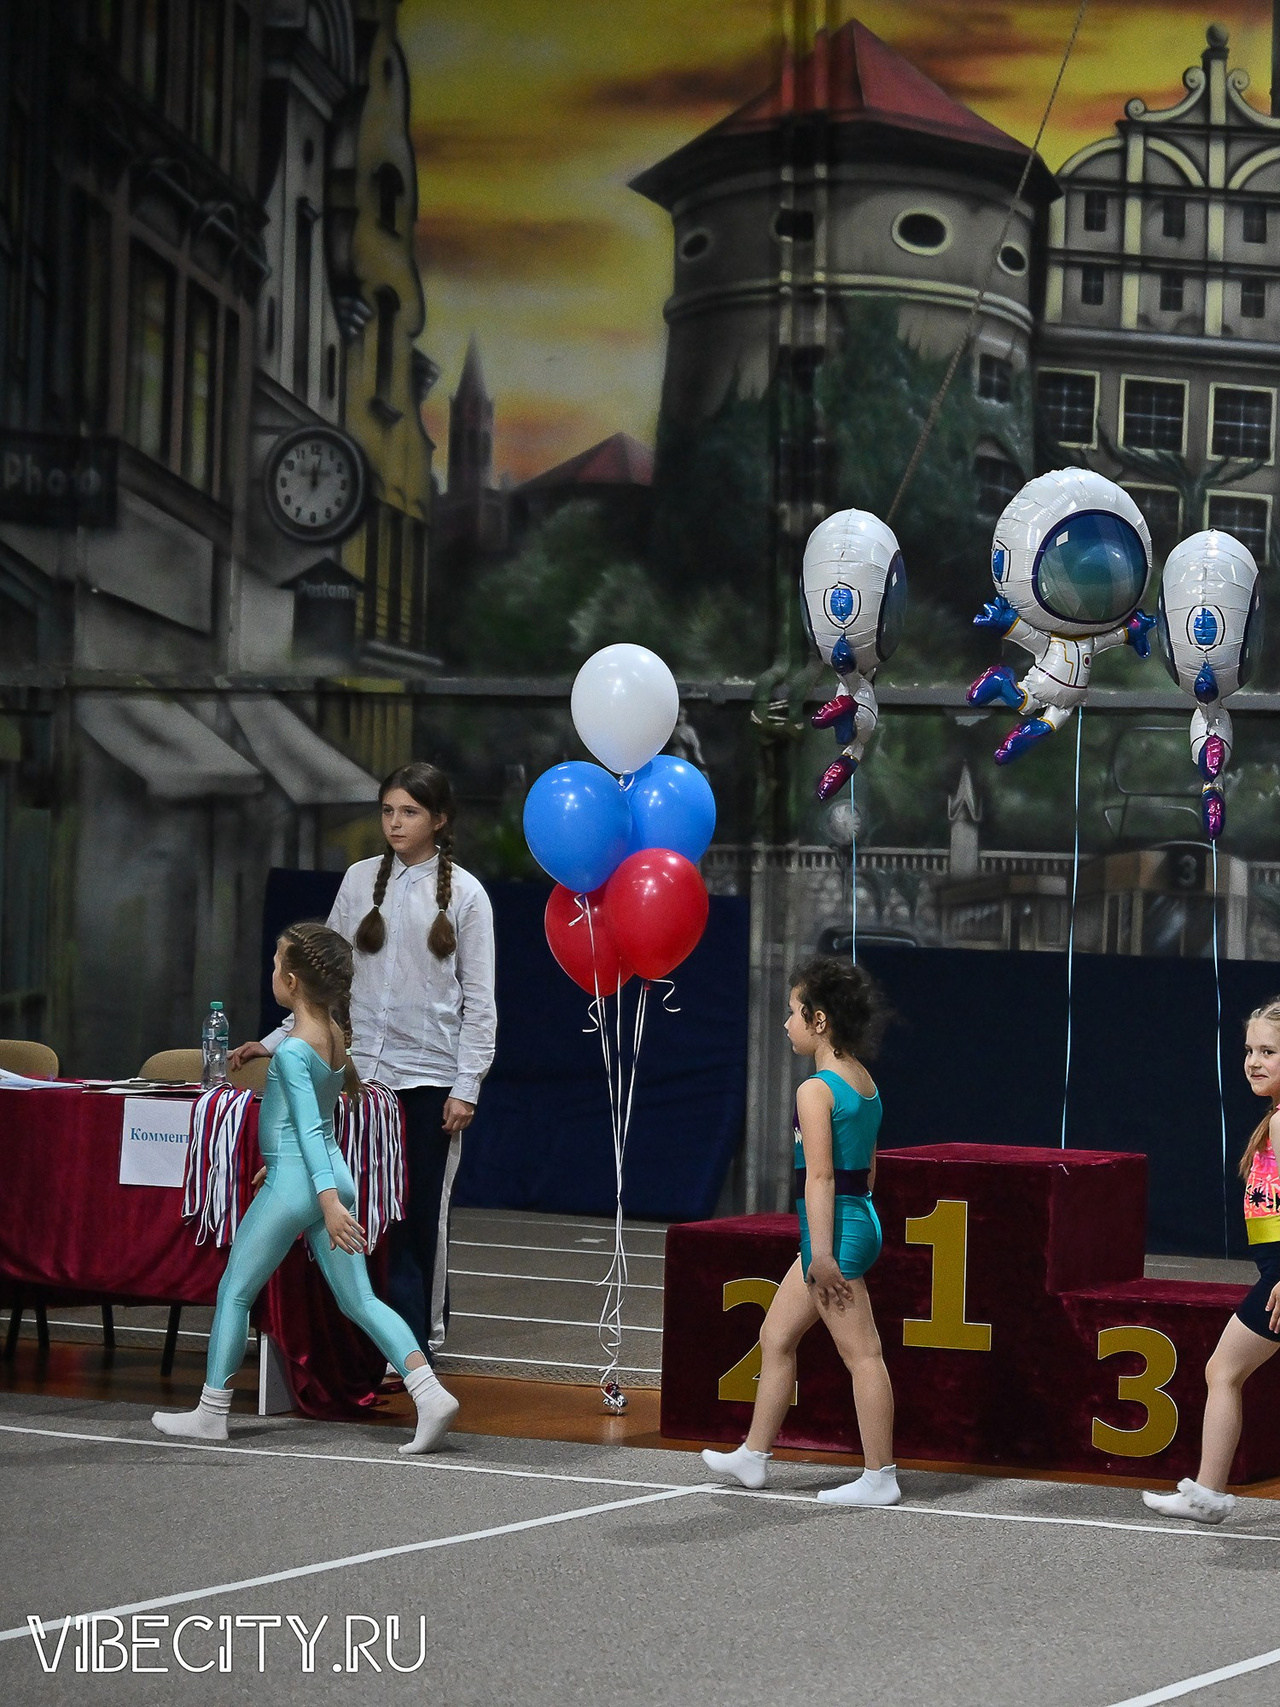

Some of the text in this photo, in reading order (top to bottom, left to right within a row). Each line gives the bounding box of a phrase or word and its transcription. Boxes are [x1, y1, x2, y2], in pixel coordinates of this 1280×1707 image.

[1178, 854, 1197, 887] 3
[903, 1199, 992, 1351] 1
[1091, 1325, 1179, 1458] 3
